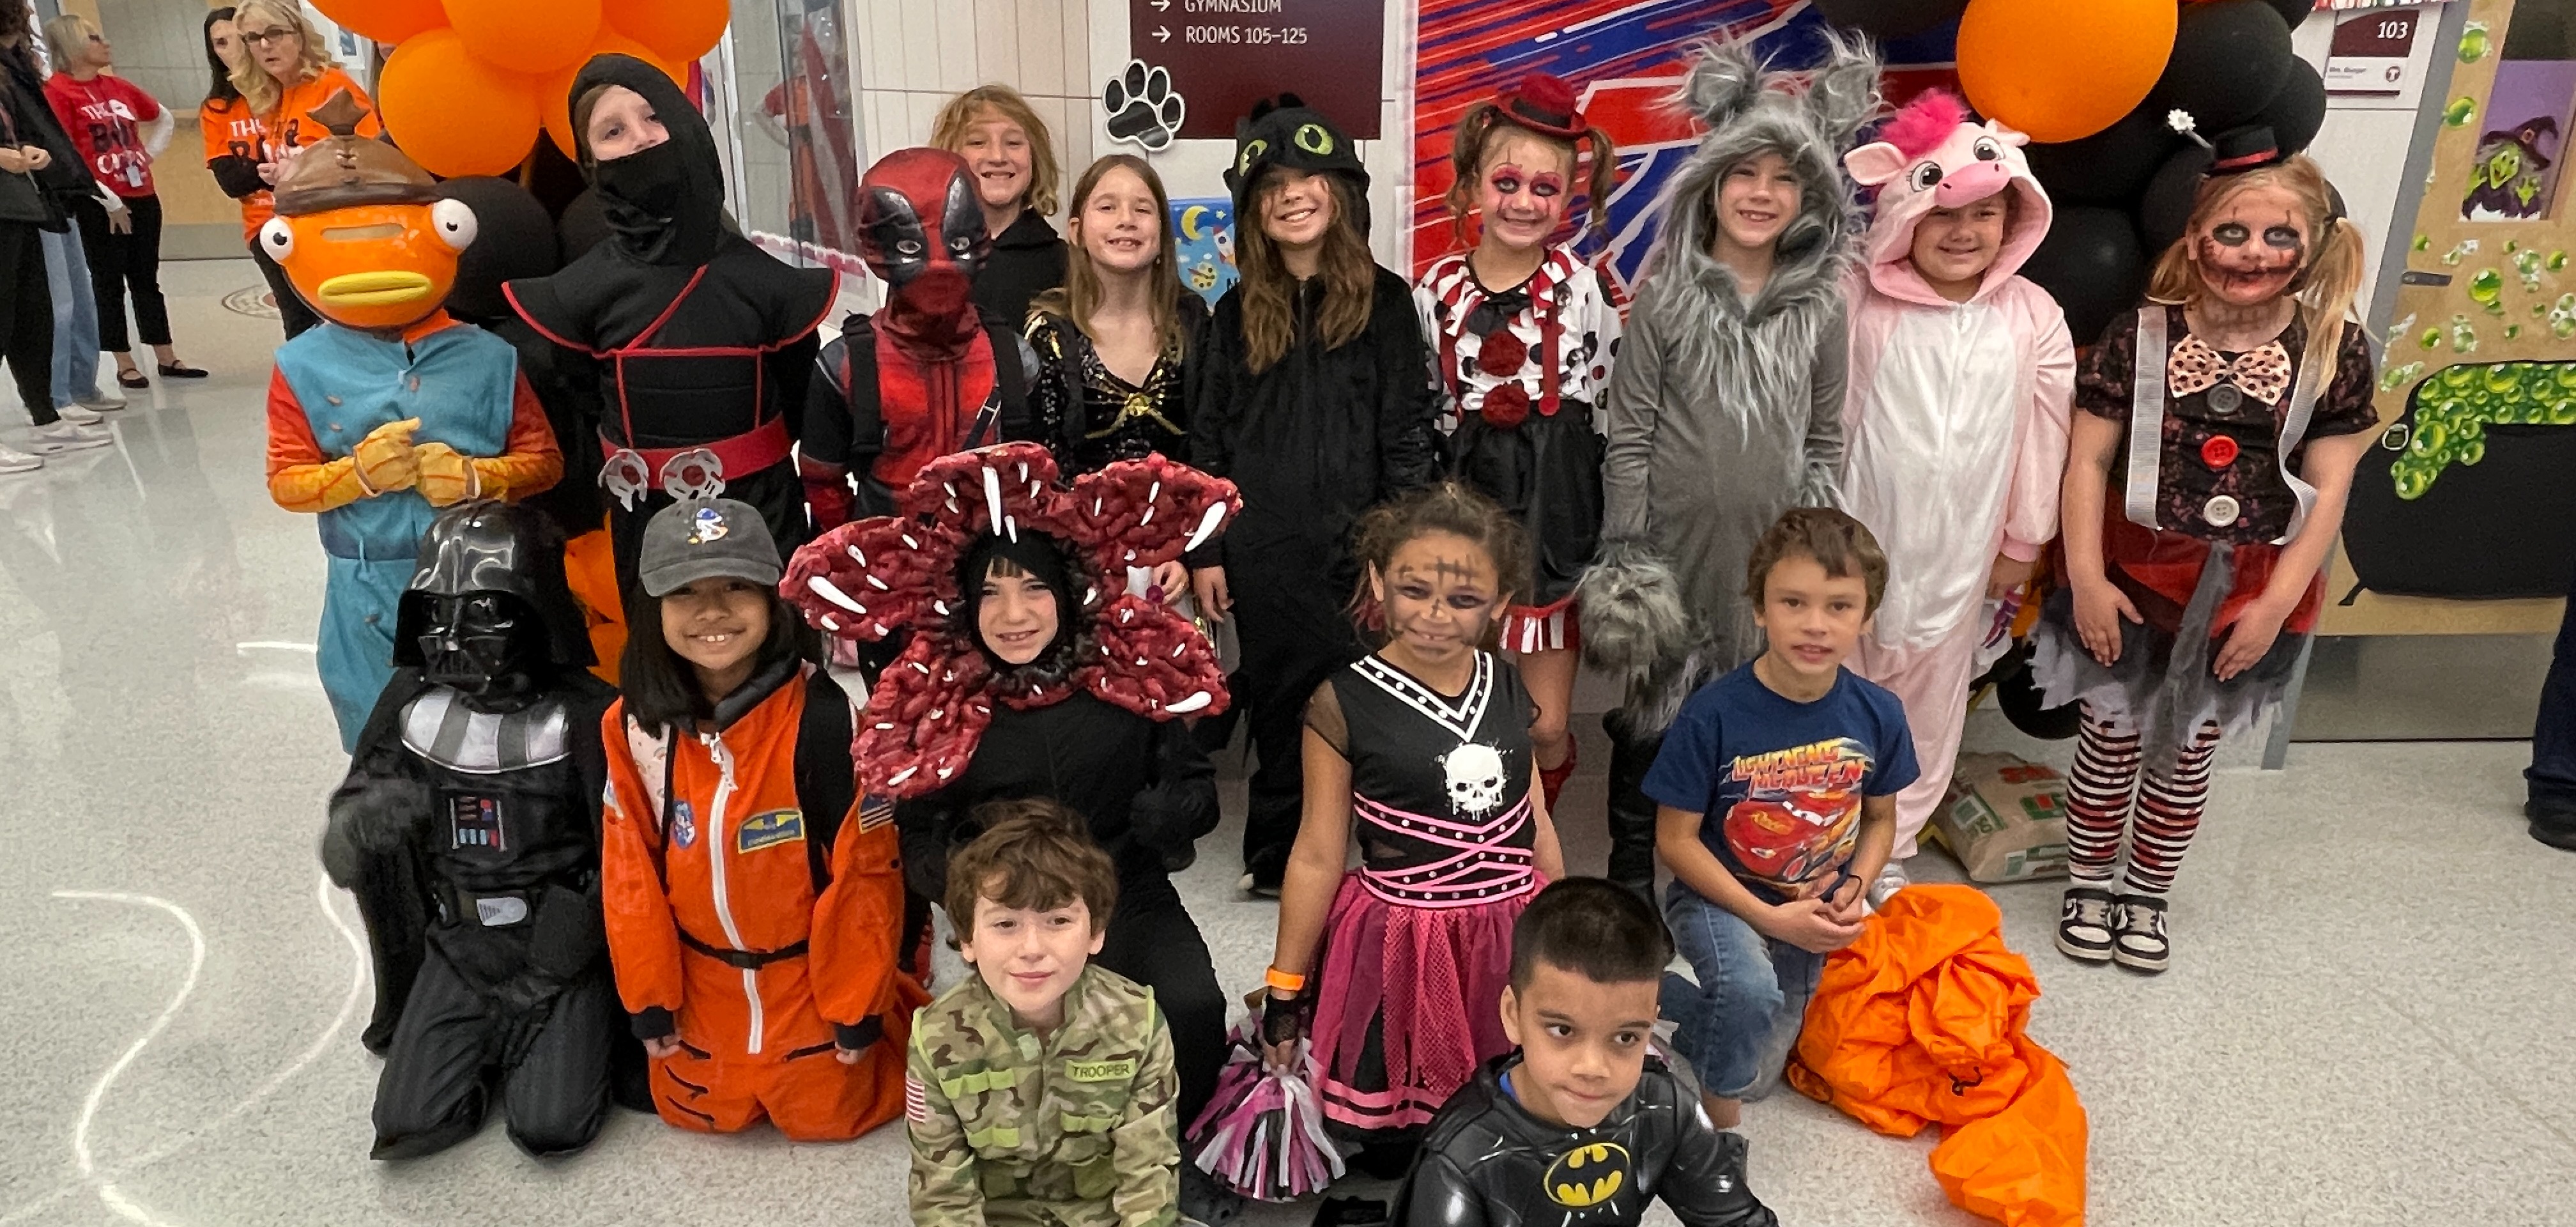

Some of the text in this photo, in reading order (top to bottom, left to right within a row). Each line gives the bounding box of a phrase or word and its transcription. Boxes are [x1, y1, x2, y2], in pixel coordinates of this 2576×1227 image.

[1184, 0, 1282, 13] GYMNASIUM
[1186, 26, 1241, 43] ROOMS
[2377, 21, 2409, 39] 103
[1073, 1063, 1130, 1077] TROOPER
